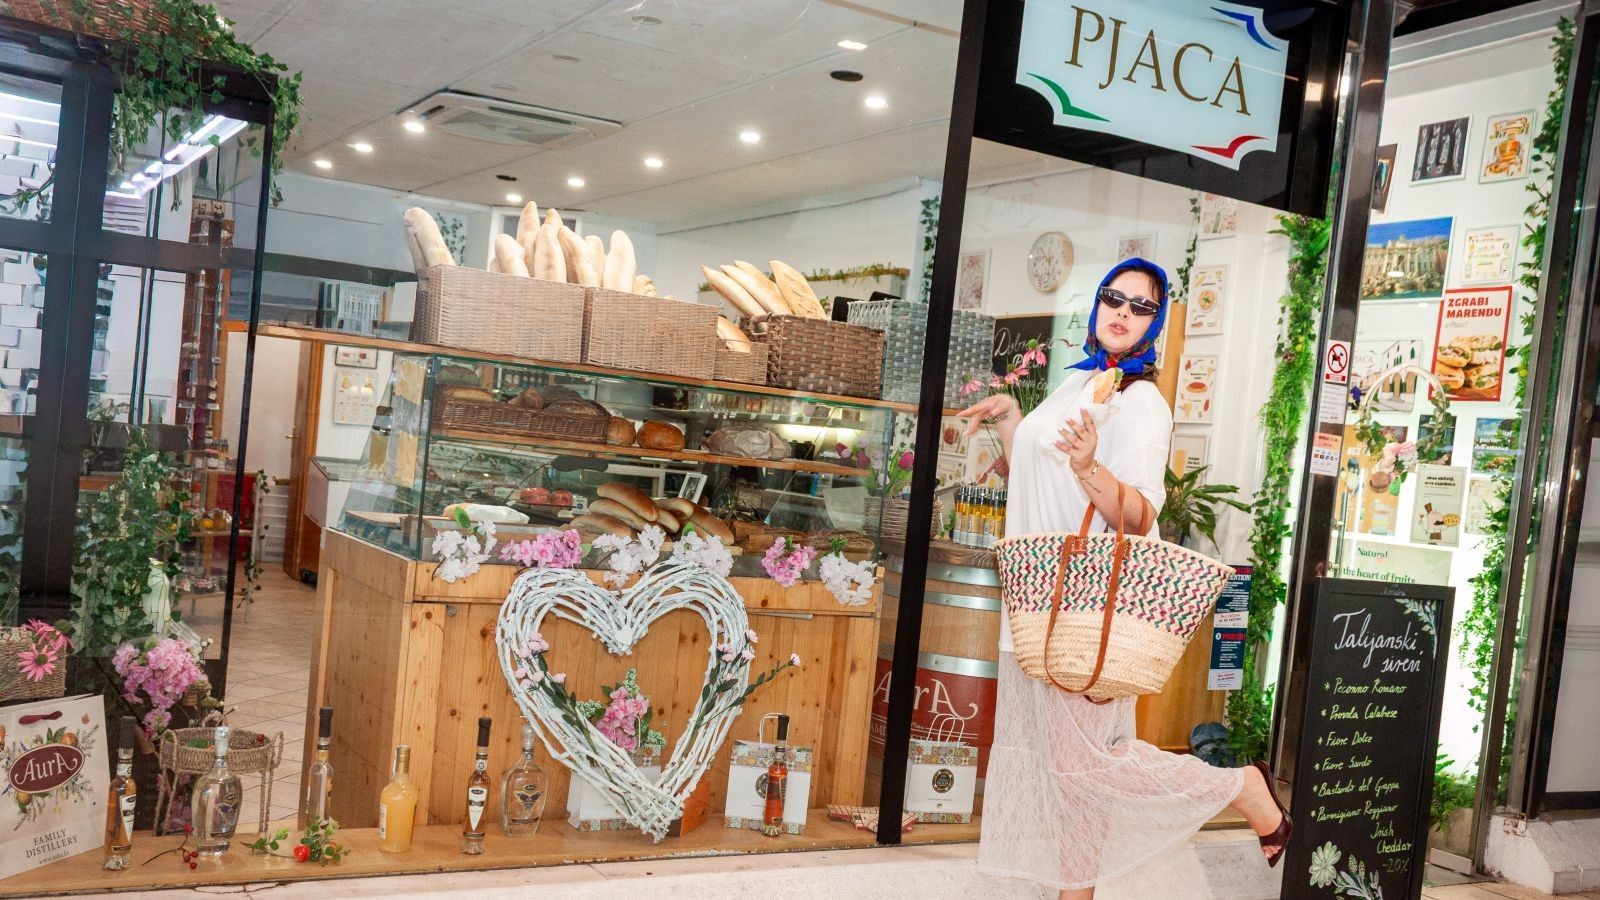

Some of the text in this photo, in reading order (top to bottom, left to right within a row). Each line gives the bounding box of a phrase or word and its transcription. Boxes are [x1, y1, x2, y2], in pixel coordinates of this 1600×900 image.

[1064, 5, 1251, 116] PJACA
[1448, 297, 1489, 307] ZGRABI
[1447, 308, 1502, 318] MARENDU
[1358, 547, 1388, 558] Natural
[1343, 566, 1416, 584] the heart of fruits
[1333, 608, 1418, 668] Talijanski
[1371, 676, 1407, 693] Romano
[873, 671, 979, 720] ArA
[1364, 702, 1398, 719] Calabrese
[1326, 731, 1373, 746] Fiore Dolce
[15, 752, 78, 784] AurA
[1322, 755, 1372, 771] Fiore Sardo
[1318, 780, 1355, 797] Bastardo
[1374, 777, 1400, 797] Grappa
[1316, 800, 1398, 823] Parmigiano Reggiano
[34, 828, 67, 846] FAMILY
[1371, 820, 1394, 839] Irish
[26, 835, 78, 859] DISTILLERY
[1376, 839, 1412, 854] Cheddar
[1382, 857, 1410, 873] -20%
